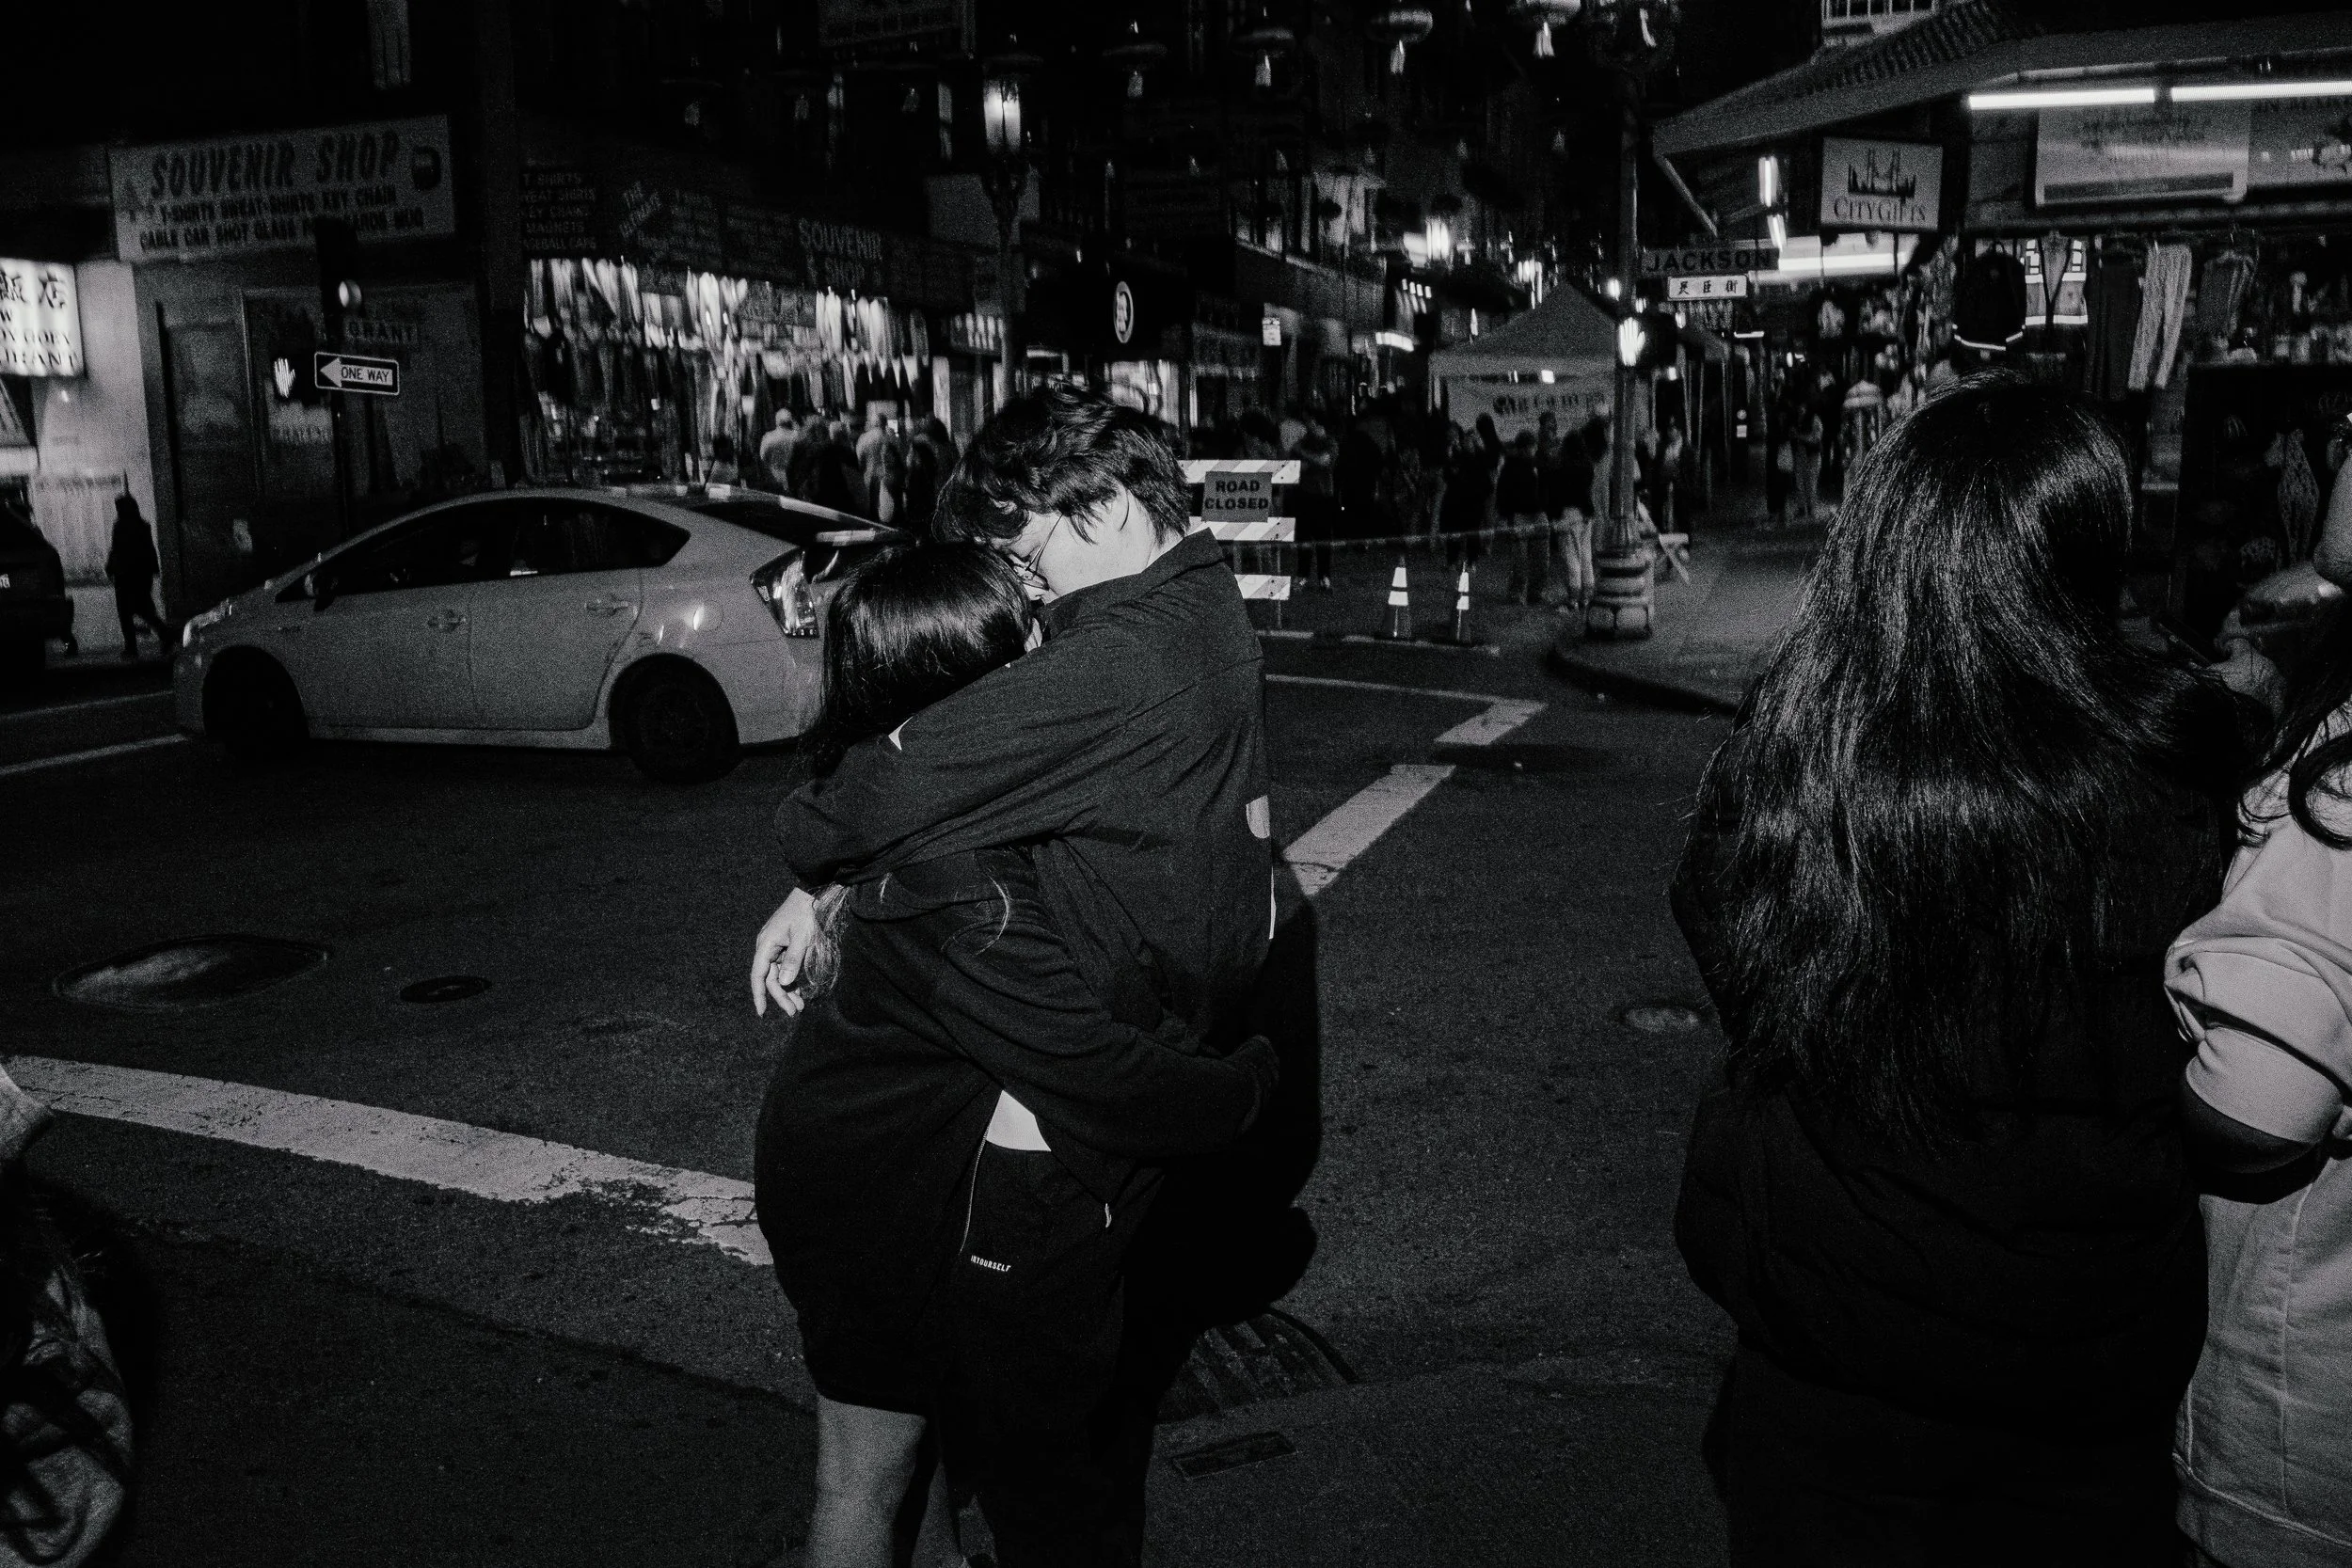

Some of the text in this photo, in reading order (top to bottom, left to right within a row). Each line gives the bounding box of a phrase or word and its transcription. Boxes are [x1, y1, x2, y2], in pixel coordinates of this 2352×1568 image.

[151, 130, 400, 198] SOUVENIR SHOP
[322, 189, 349, 210] KEY
[184, 226, 211, 247] CAR
[216, 222, 249, 245] SHOT
[1646, 249, 1771, 272] JACKSON
[348, 320, 413, 341] GRANT
[341, 366, 389, 383] ONE WAY
[1215, 479, 1261, 494] ROAD
[1204, 498, 1269, 510] CLOSED
